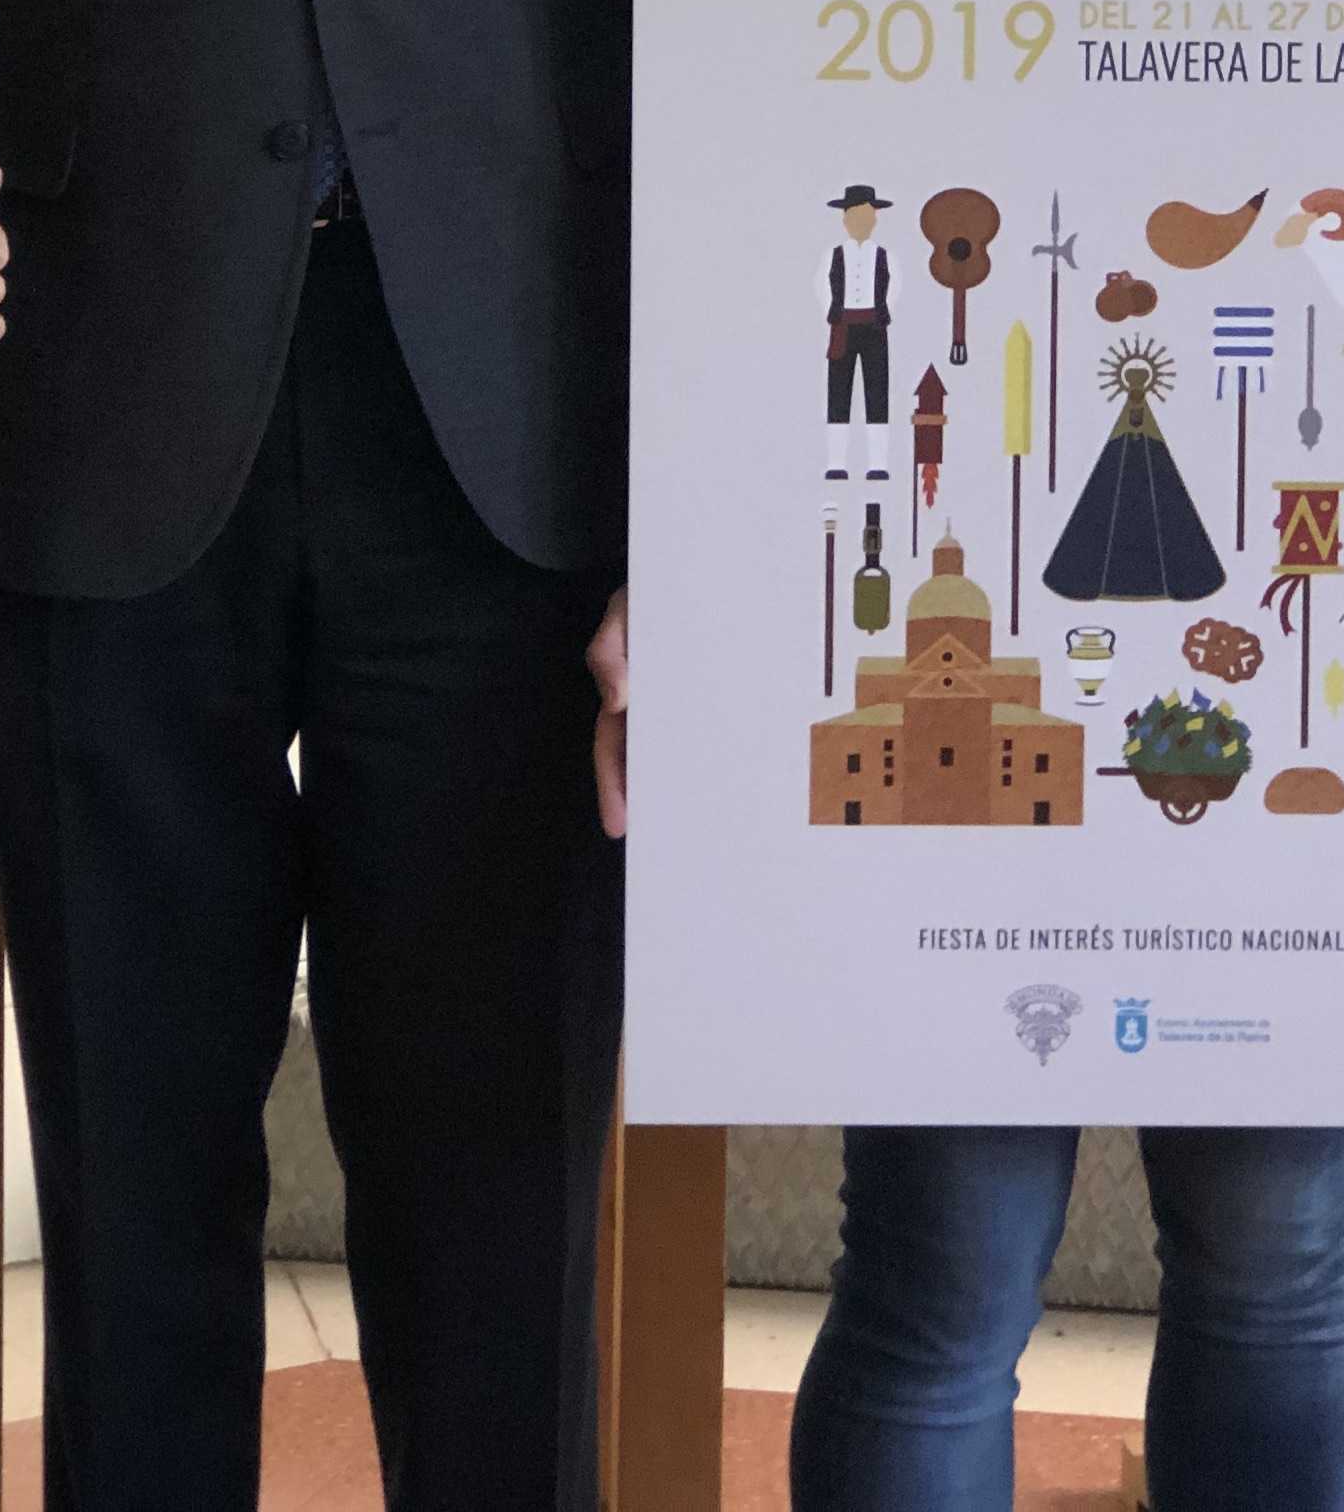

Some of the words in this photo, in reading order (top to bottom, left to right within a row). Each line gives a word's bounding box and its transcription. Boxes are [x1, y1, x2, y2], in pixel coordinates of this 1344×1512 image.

[1079, 0, 1138, 31] DEL
[1152, 0, 1193, 31] 21
[1211, 1, 1254, 32] AL
[1268, 1, 1310, 33] 27
[1078, 39, 1250, 84] TALAVERA
[1261, 41, 1303, 84] DE
[918, 928, 987, 950] FIESTA
[996, 928, 1021, 950] DE
[1030, 924, 1114, 951] INTERÉS
[1123, 924, 1233, 951] TURÍSTICO
[1242, 929, 1344, 952] NACIONAL
